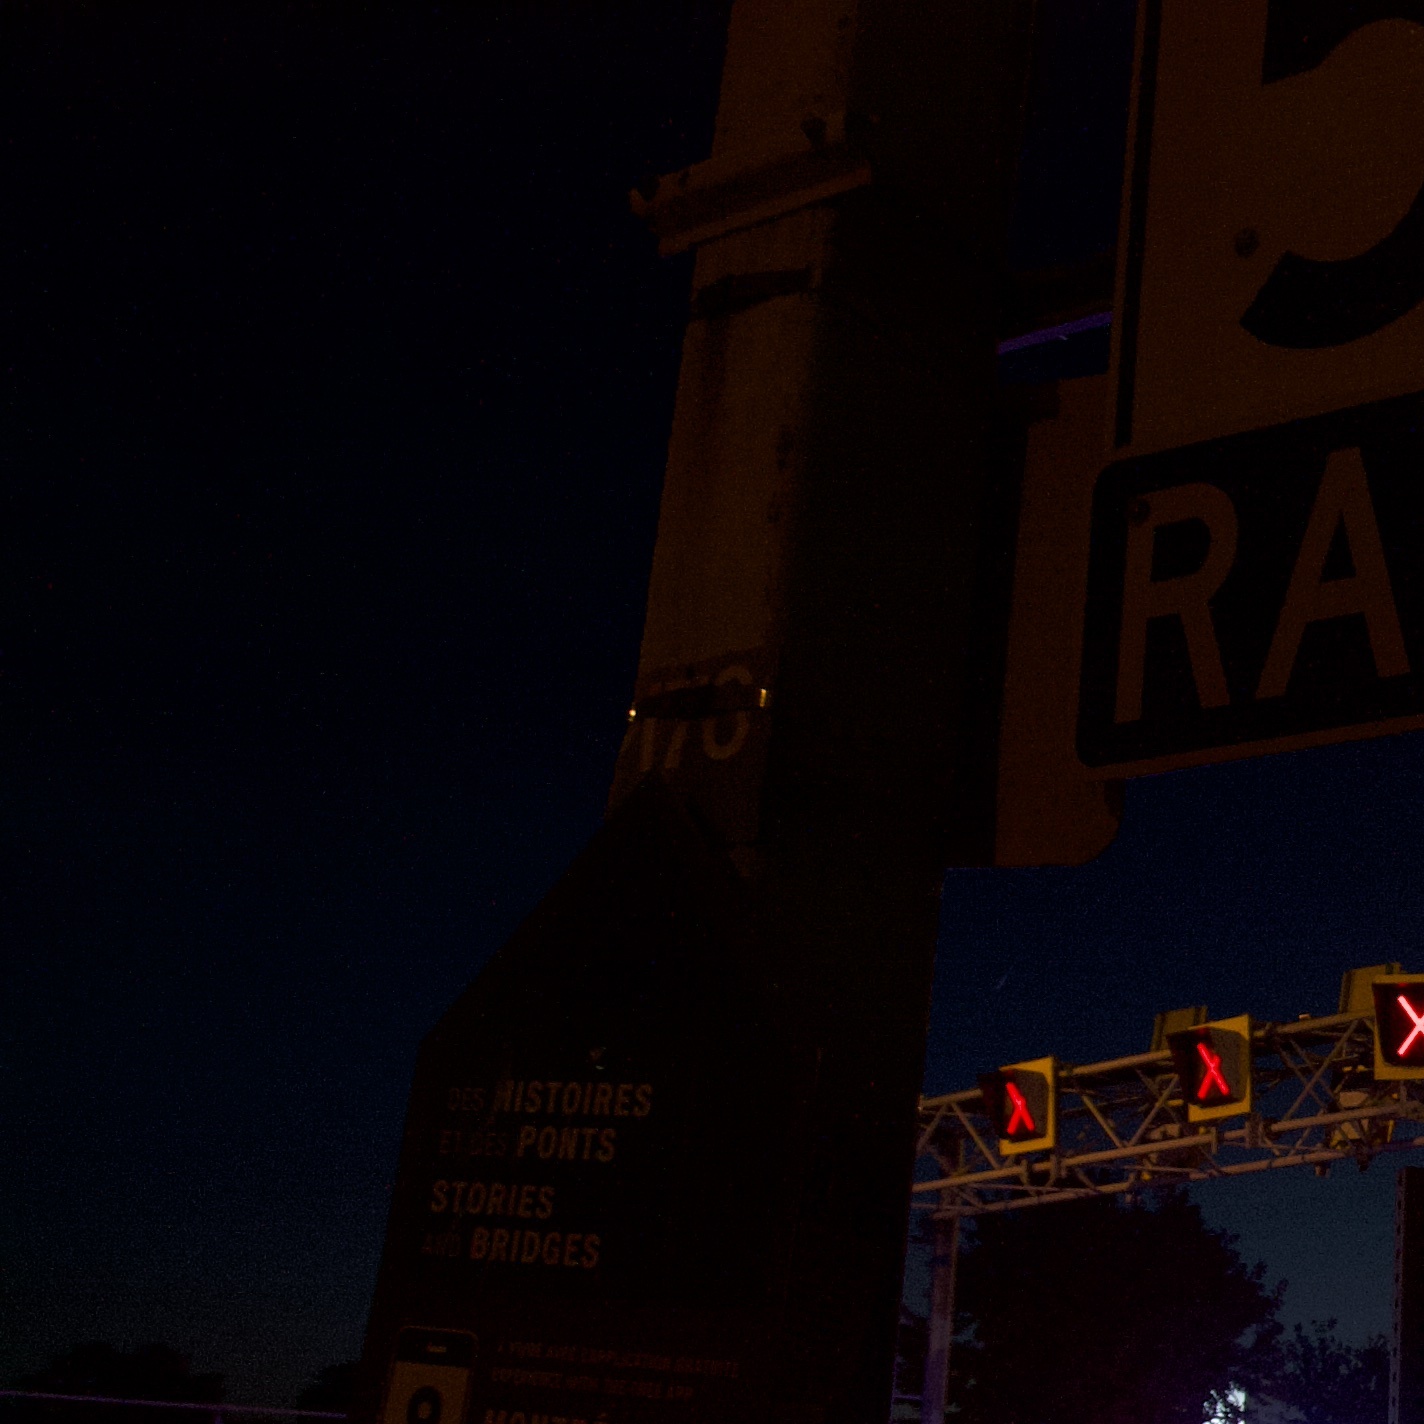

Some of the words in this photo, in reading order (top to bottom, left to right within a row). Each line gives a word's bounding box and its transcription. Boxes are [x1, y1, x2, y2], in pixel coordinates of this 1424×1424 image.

[492, 1079, 654, 1118] HISTOIRES
[516, 1124, 618, 1163] PONTS
[429, 1179, 556, 1219] STORIES
[469, 1226, 602, 1269] BRIDGES
